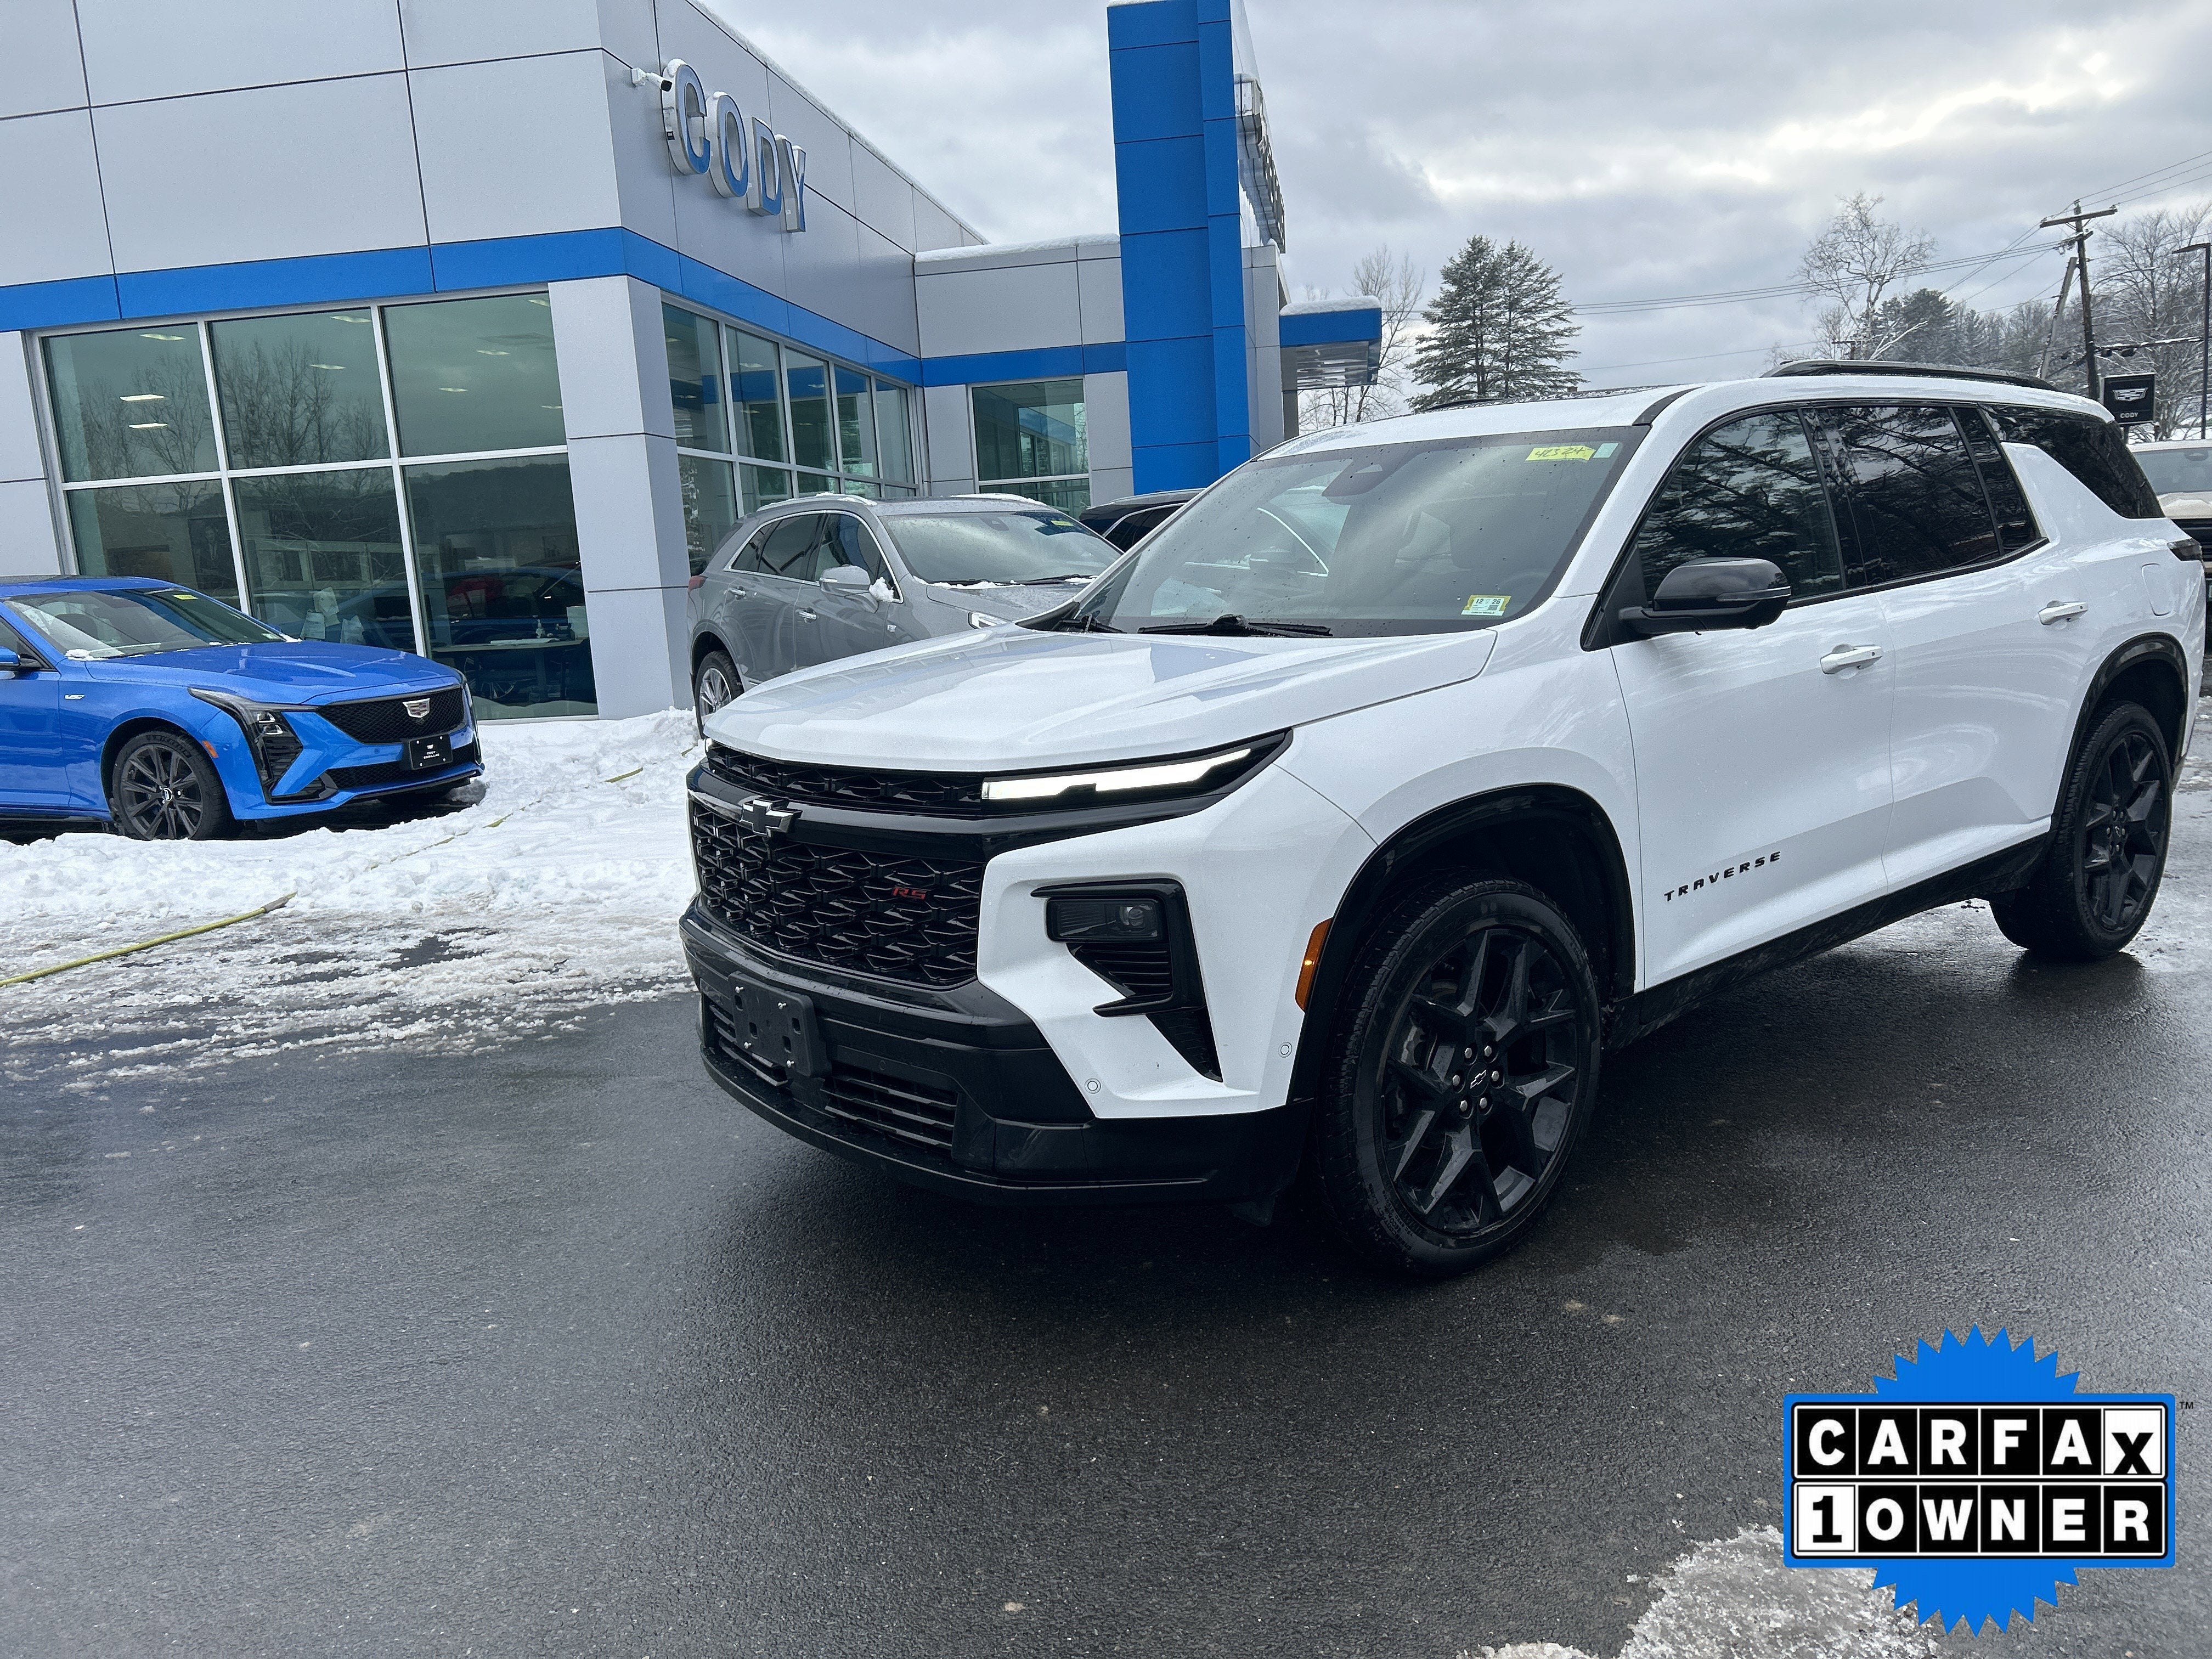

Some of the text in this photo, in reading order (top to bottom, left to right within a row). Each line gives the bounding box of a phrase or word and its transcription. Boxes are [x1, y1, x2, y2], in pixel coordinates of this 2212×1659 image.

[662, 61, 806, 233] CODY
[891, 886, 927, 900] RS
[1664, 851, 1781, 901] TRAVERSE
